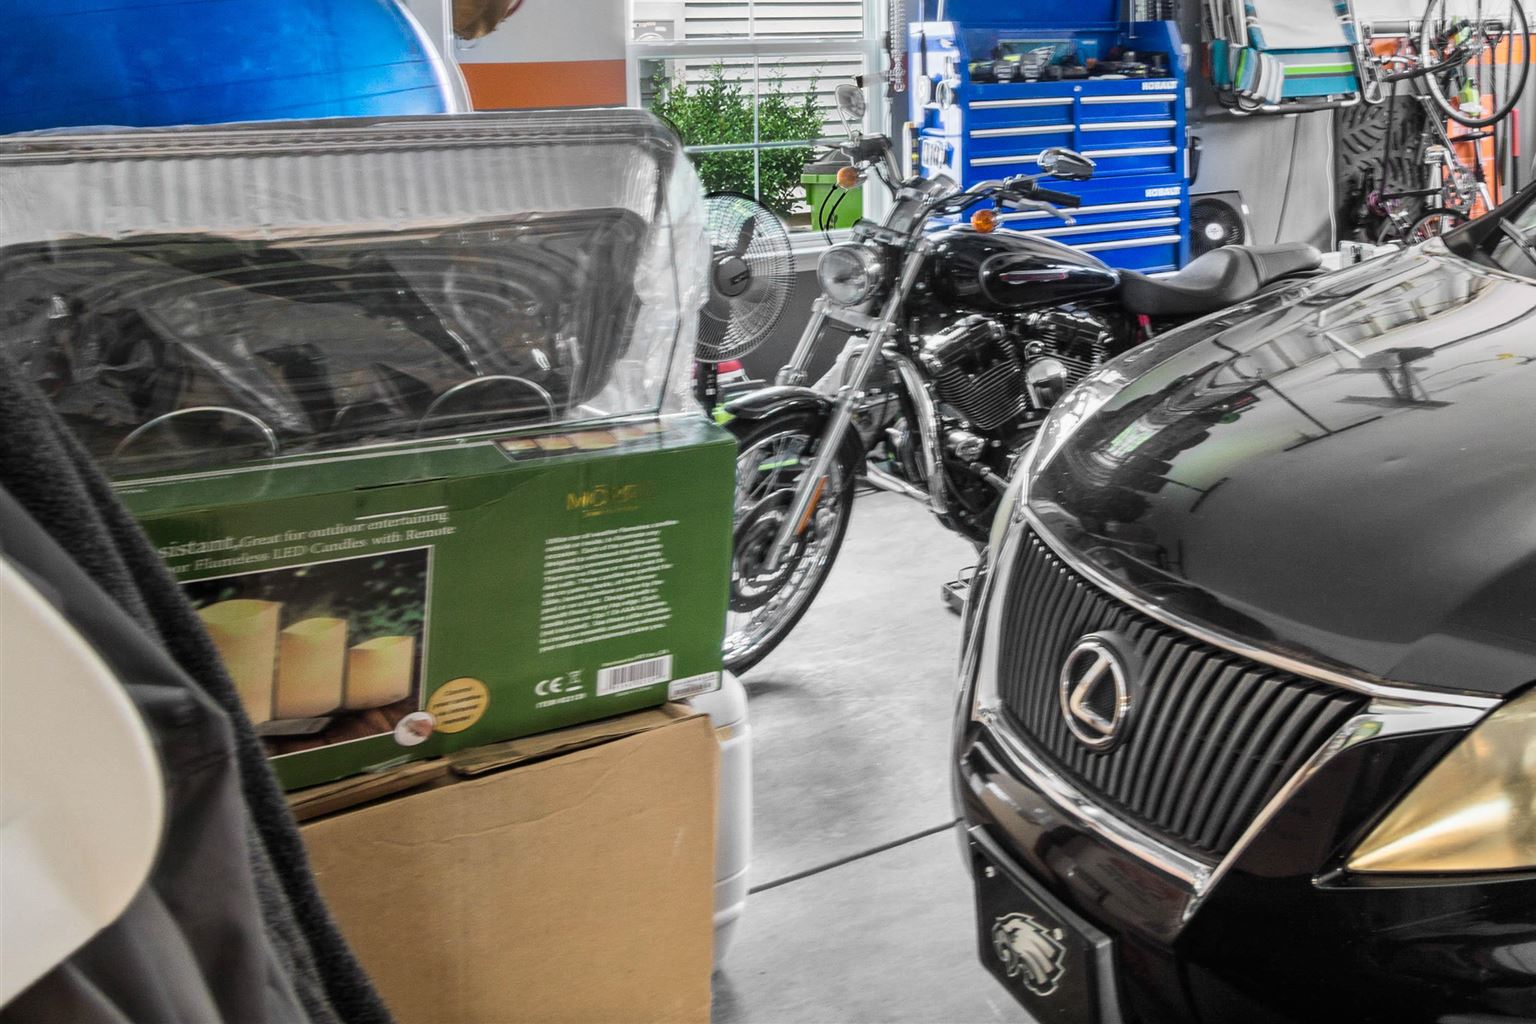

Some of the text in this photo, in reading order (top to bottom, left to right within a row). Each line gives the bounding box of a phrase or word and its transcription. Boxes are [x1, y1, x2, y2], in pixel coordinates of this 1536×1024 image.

[284, 529, 307, 543] for
[308, 523, 366, 538] outdoor
[367, 511, 449, 531] entertaining
[194, 553, 269, 572] Flameless
[273, 545, 308, 560] LED
[310, 537, 368, 554] Candles
[372, 533, 401, 546] with
[406, 526, 456, 541] Remote
